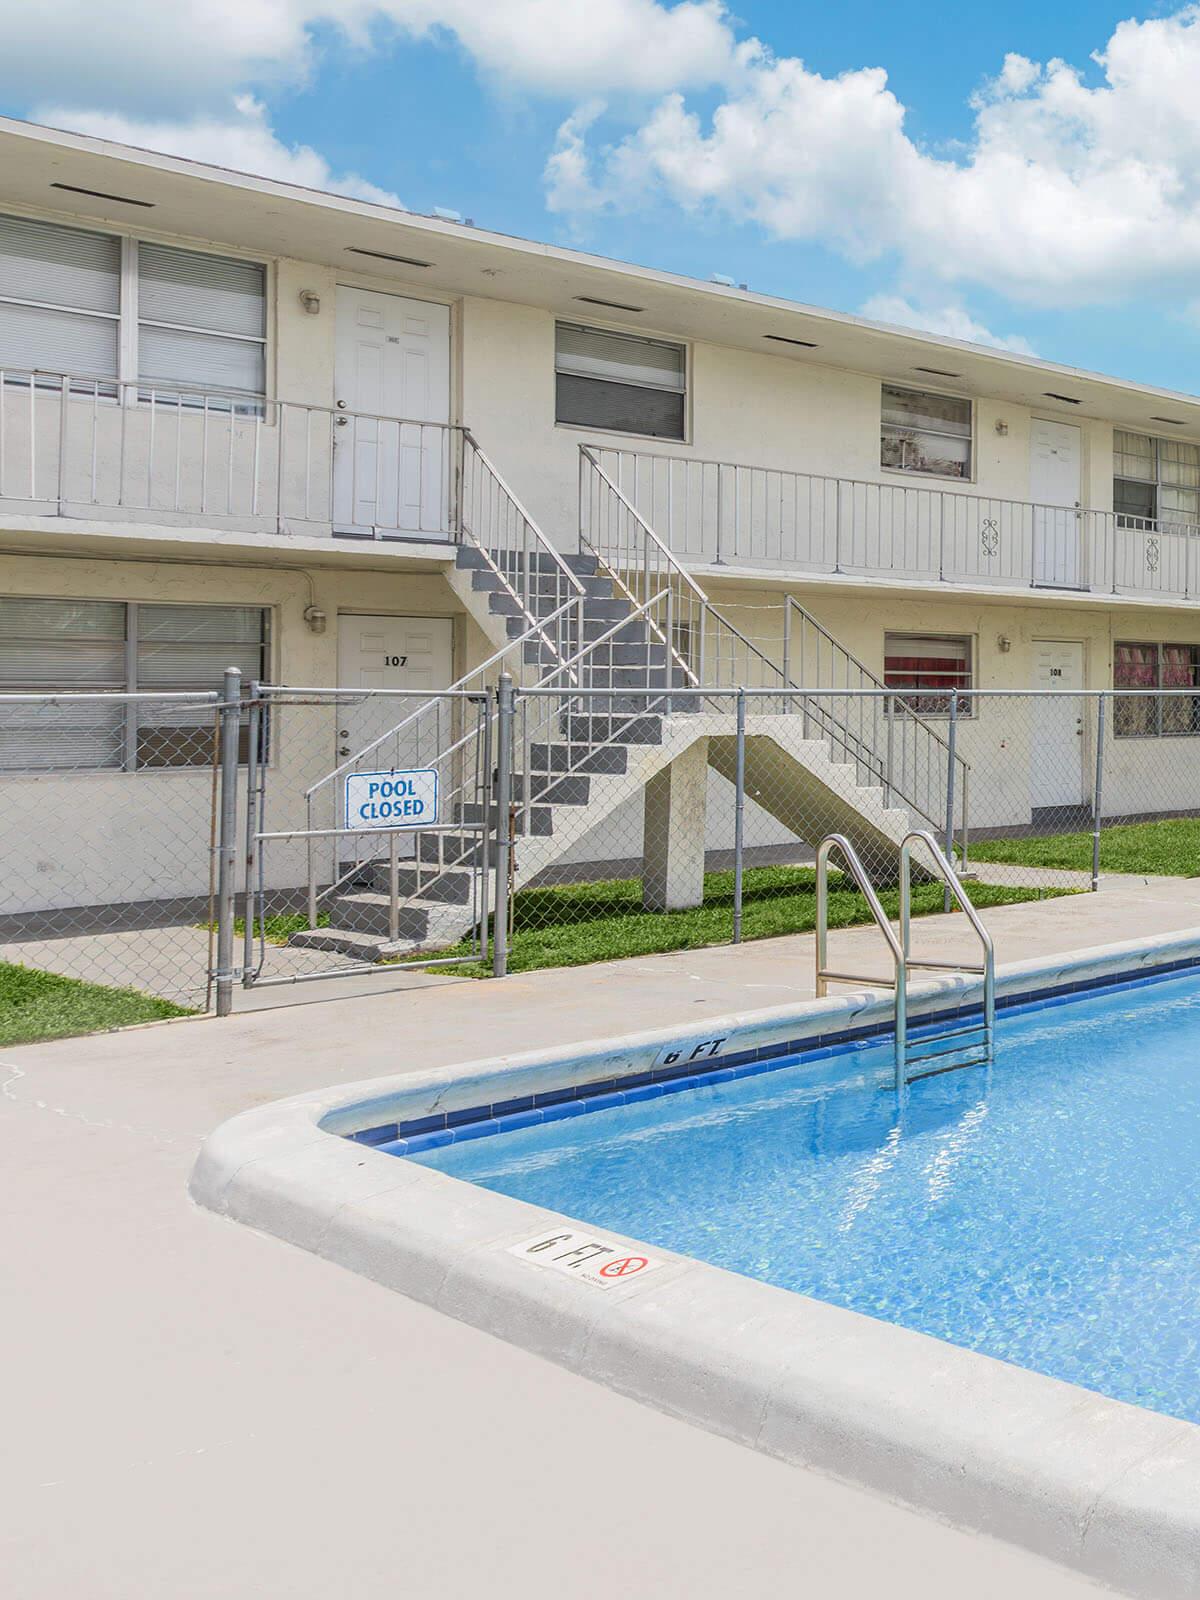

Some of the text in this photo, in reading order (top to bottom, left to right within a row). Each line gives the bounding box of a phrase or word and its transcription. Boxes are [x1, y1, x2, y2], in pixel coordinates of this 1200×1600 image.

[384, 656, 408, 667] 107
[369, 780, 416, 799] POOL
[359, 799, 424, 820] CLOSED
[663, 1049, 683, 1064] 6
[526, 1234, 573, 1253] 6
